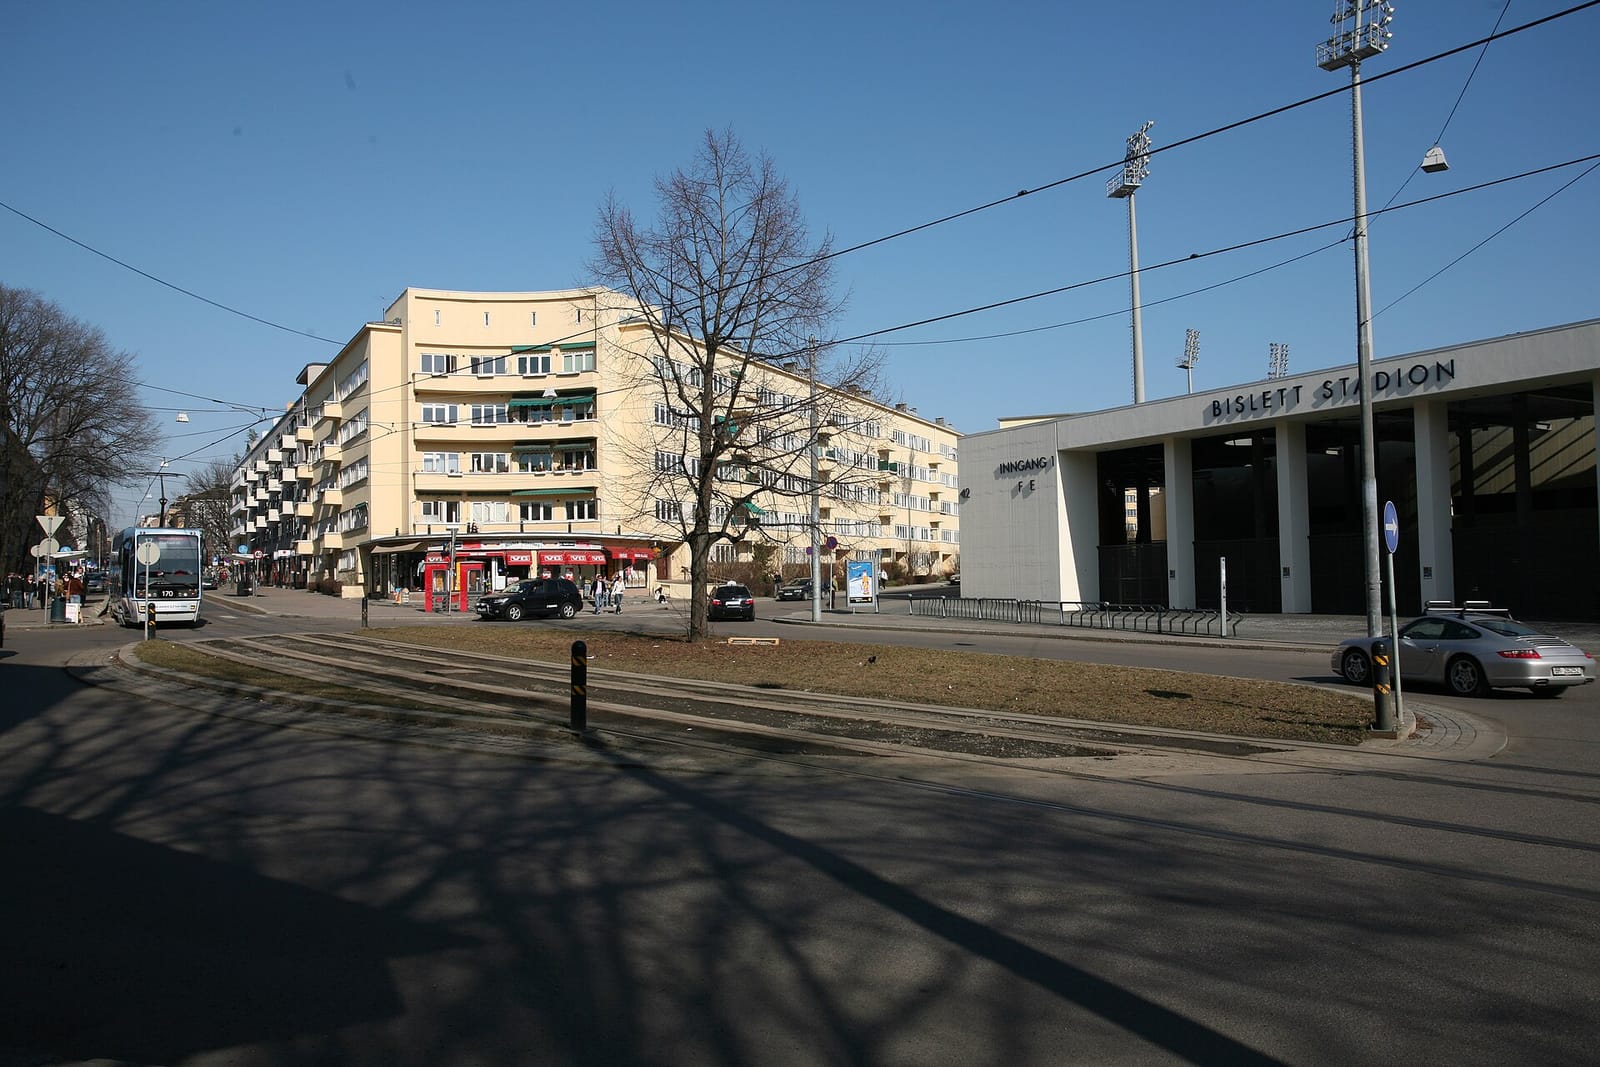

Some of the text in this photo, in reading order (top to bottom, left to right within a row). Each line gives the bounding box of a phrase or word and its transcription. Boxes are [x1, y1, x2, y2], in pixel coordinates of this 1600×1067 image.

[1212, 385, 1303, 417] BISLETT
[999, 457, 1047, 474] INNGANG
[1018, 480, 1035, 493] F E
